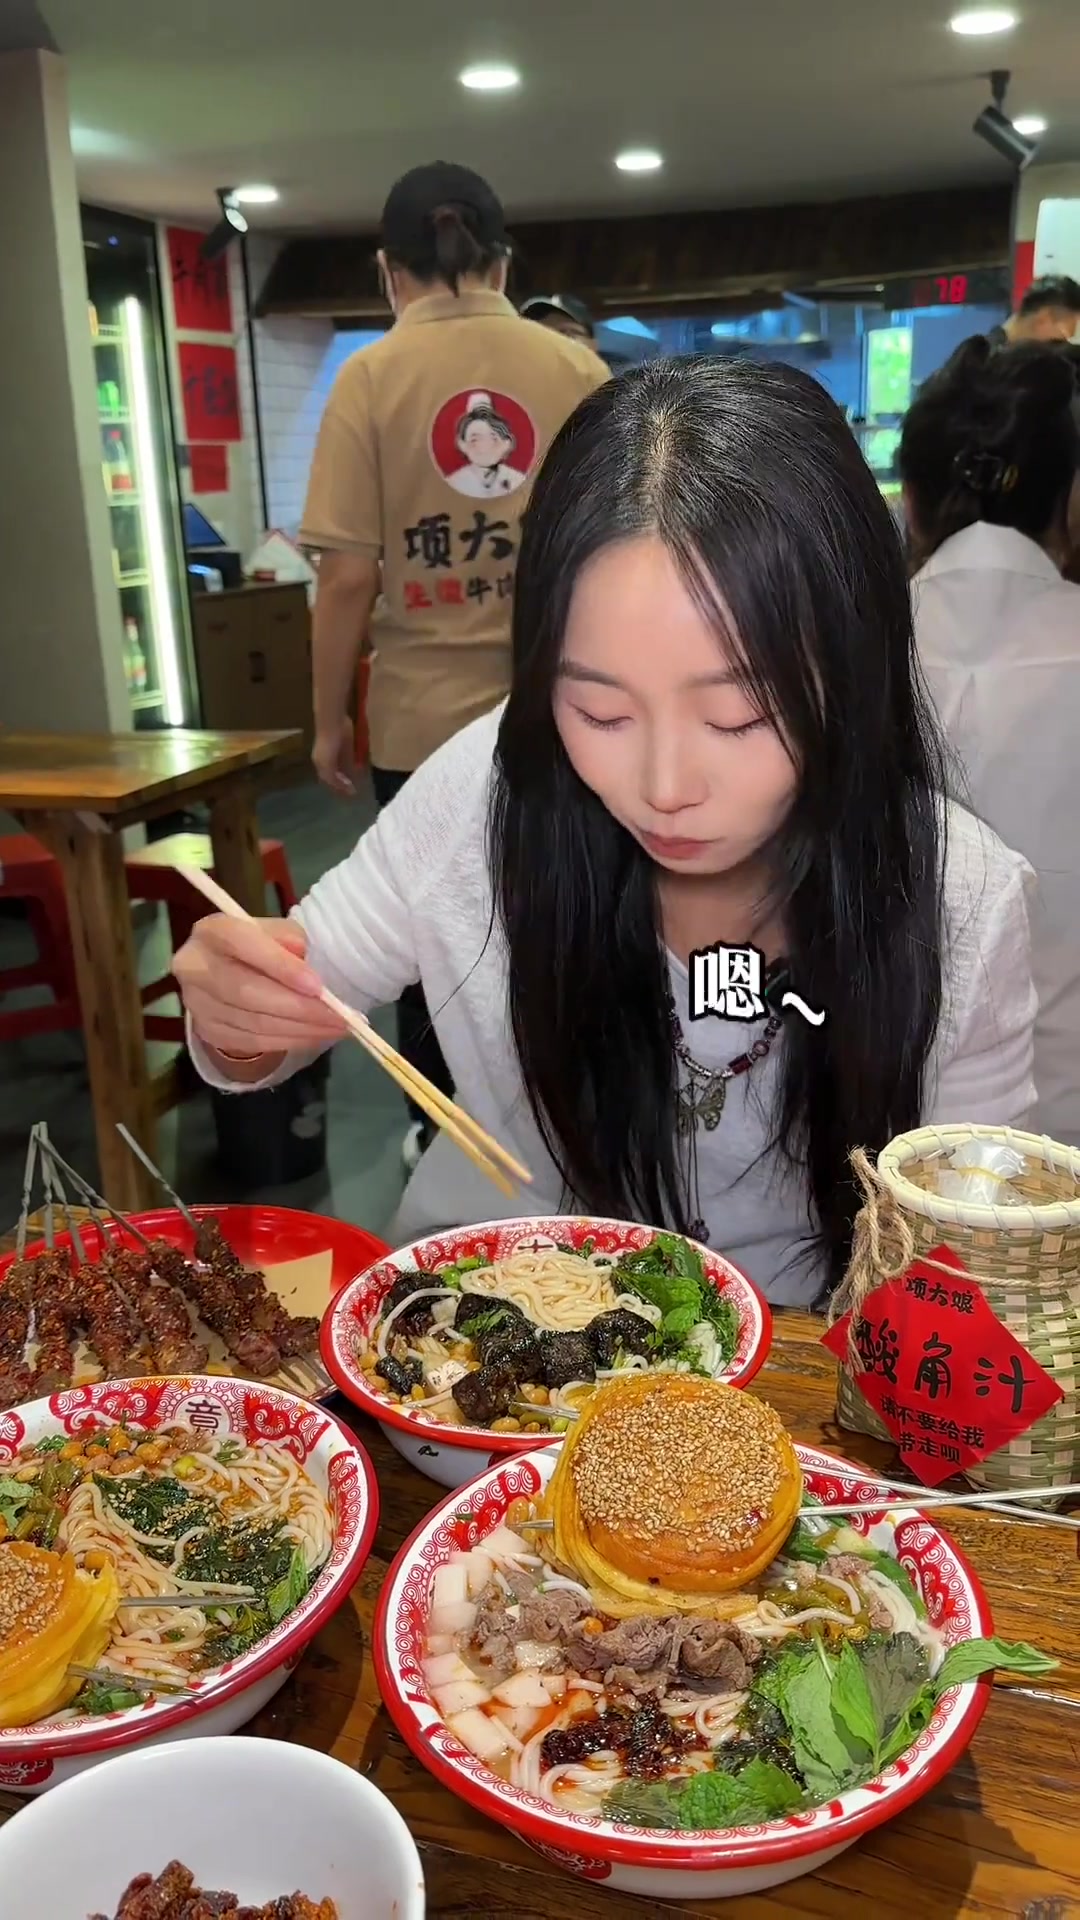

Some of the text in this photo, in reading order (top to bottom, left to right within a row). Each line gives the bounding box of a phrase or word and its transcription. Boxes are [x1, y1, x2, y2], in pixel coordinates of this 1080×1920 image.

[403, 510, 523, 568] 项大
[905, 1276, 974, 1314] 项大娘
[856, 1315, 1036, 1413] 酸角汁
[881, 1395, 985, 1448] 请不要给我
[899, 1431, 961, 1466] 带走呗
